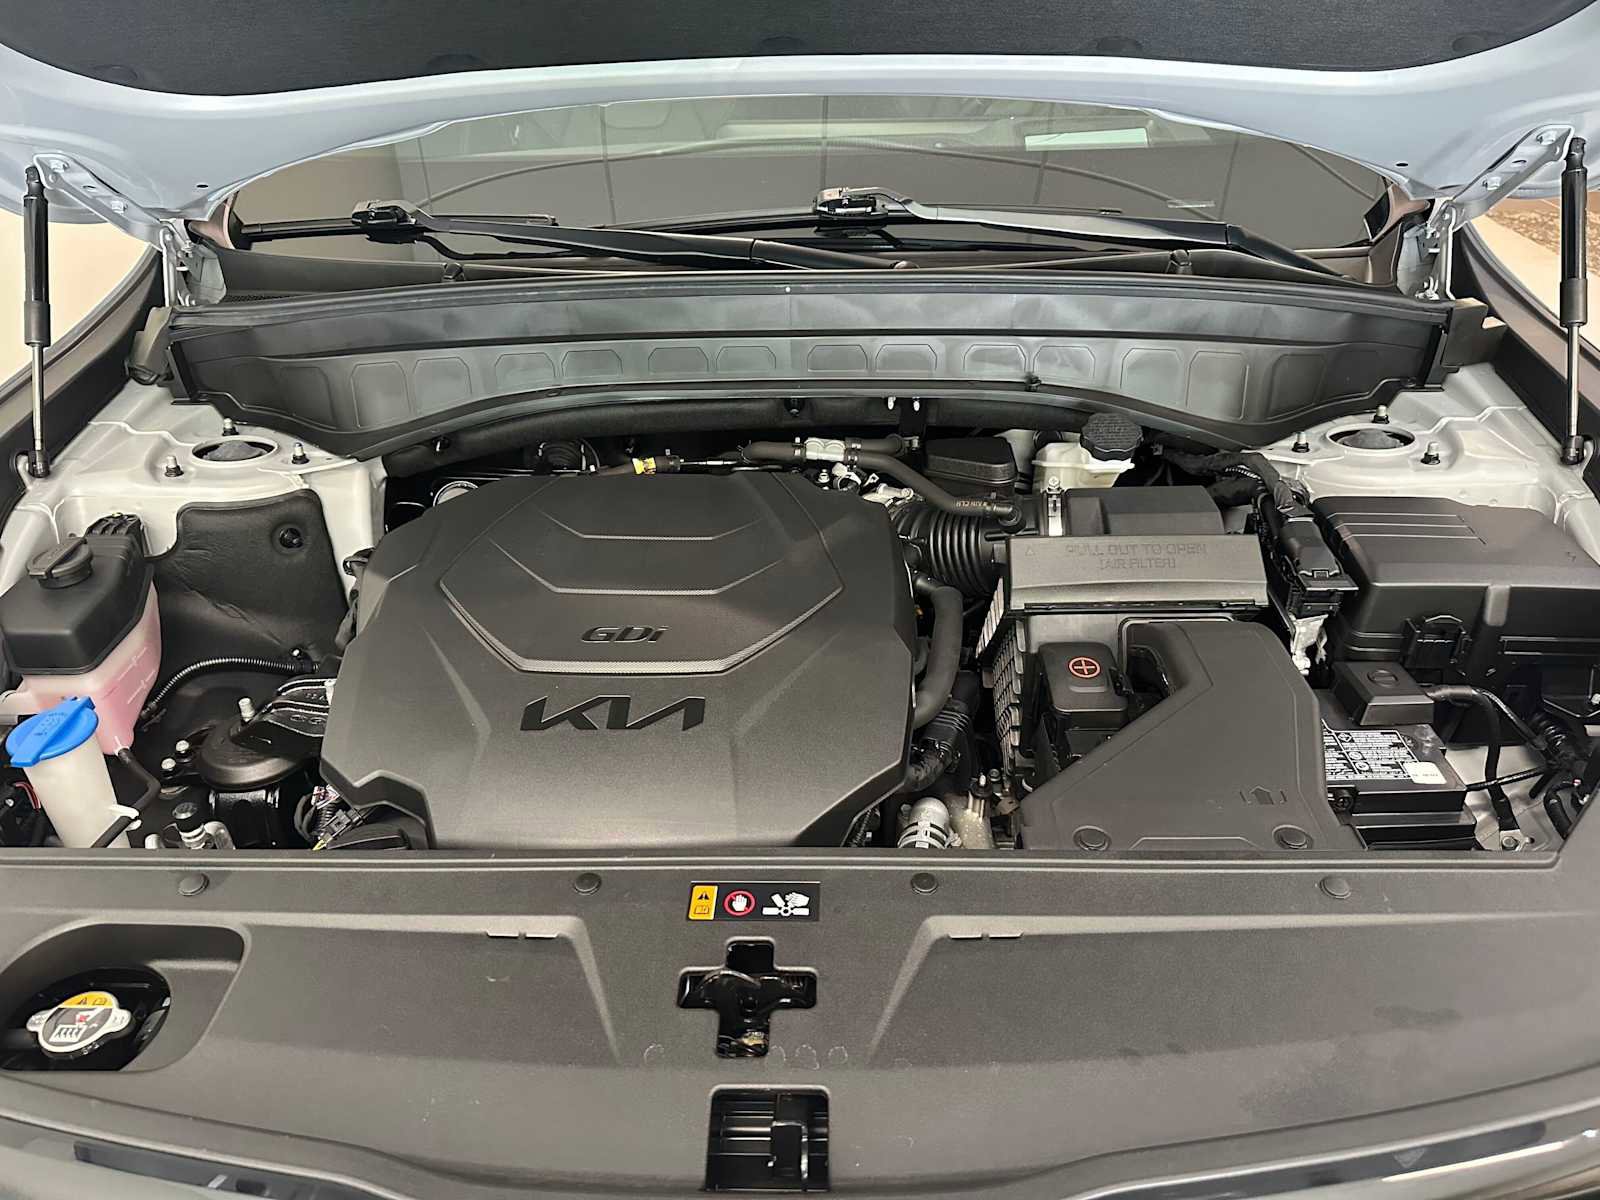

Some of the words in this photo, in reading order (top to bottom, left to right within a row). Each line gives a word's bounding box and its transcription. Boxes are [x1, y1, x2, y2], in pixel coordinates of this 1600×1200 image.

[1065, 543, 1104, 556] PULL
[1108, 543, 1138, 555] OUT
[1141, 543, 1162, 555] TO
[1166, 543, 1206, 555] OPEN
[520, 694, 706, 731] KIA
